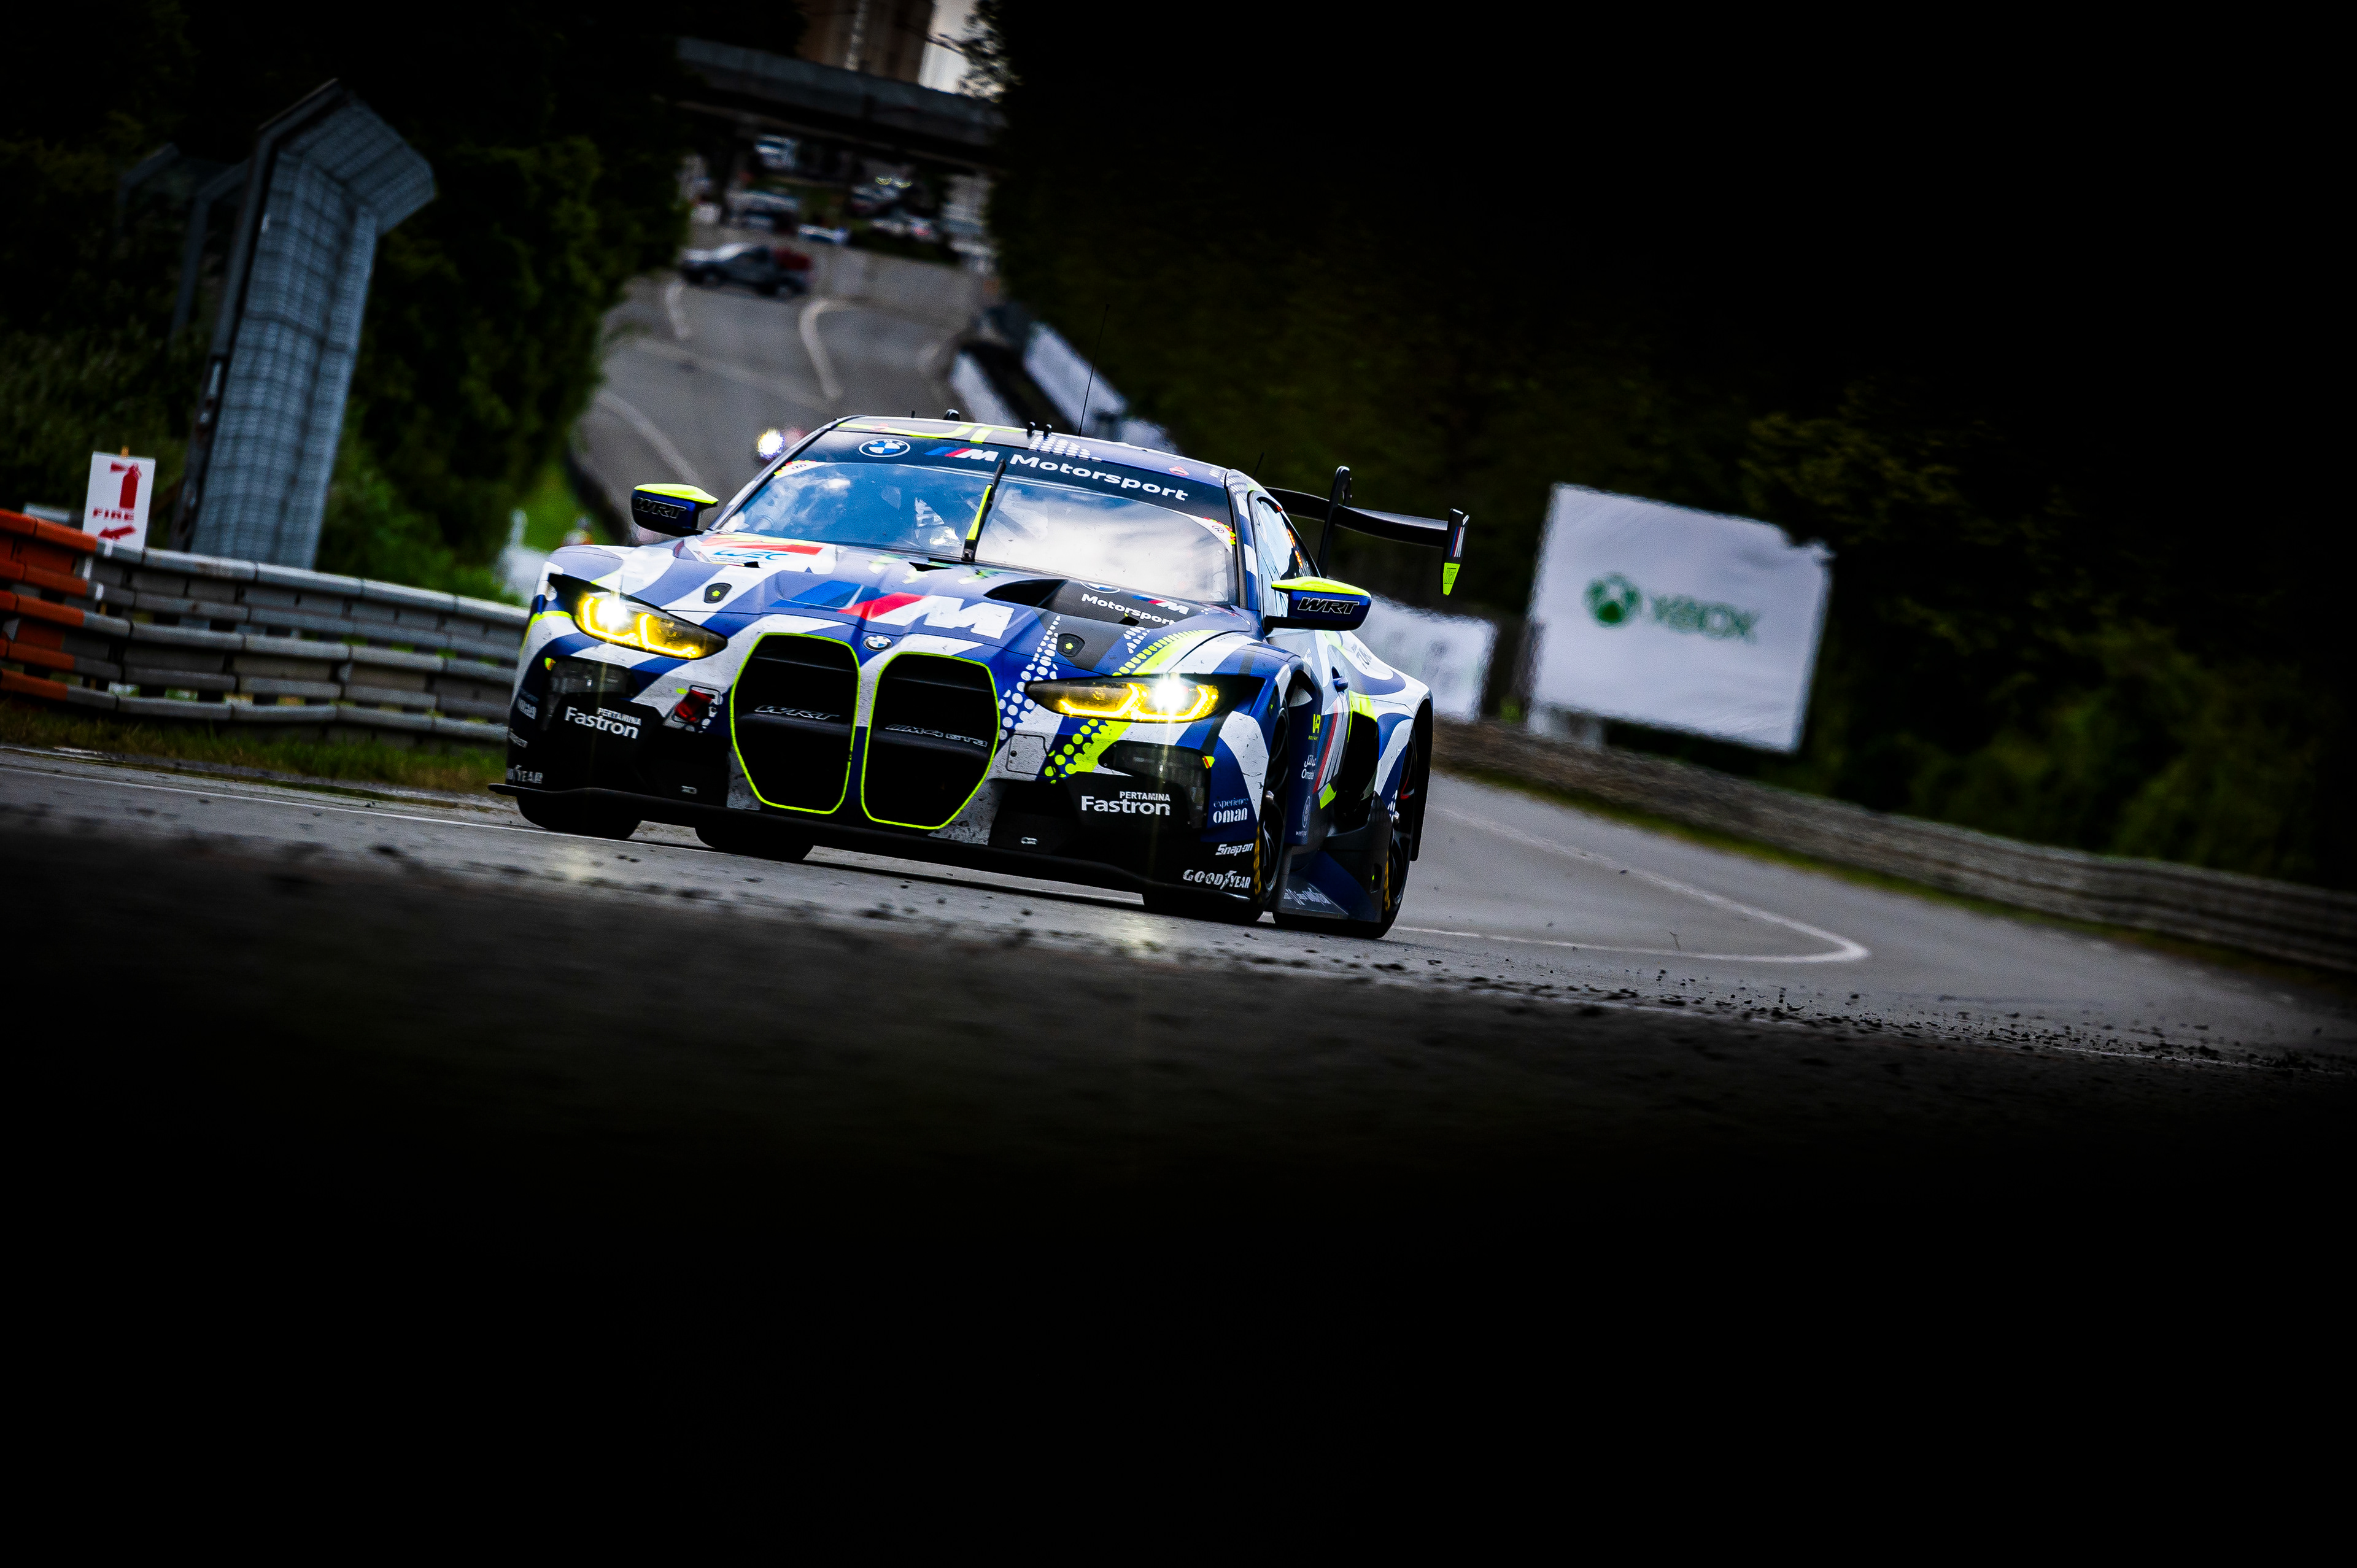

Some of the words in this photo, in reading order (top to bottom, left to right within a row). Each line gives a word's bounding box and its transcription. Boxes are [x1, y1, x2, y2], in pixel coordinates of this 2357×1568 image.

[1010, 454, 1188, 501] Motorsport
[92, 507, 134, 522] FIRE
[634, 496, 687, 519] WRT
[713, 550, 789, 561] WEC
[1081, 593, 1176, 626] Motorsport
[1297, 597, 1360, 615] WRT
[867, 595, 1015, 639] M
[754, 705, 841, 720] WRT
[565, 706, 639, 739] Fastron
[946, 733, 988, 747] GT3
[1120, 790, 1171, 802] PERTAMINA
[1213, 797, 1249, 809] experience
[1081, 795, 1171, 816] Fastron
[1213, 808, 1248, 823] oman
[1215, 843, 1254, 856] Snap-on
[1183, 869, 1251, 890] GOODYEAR
